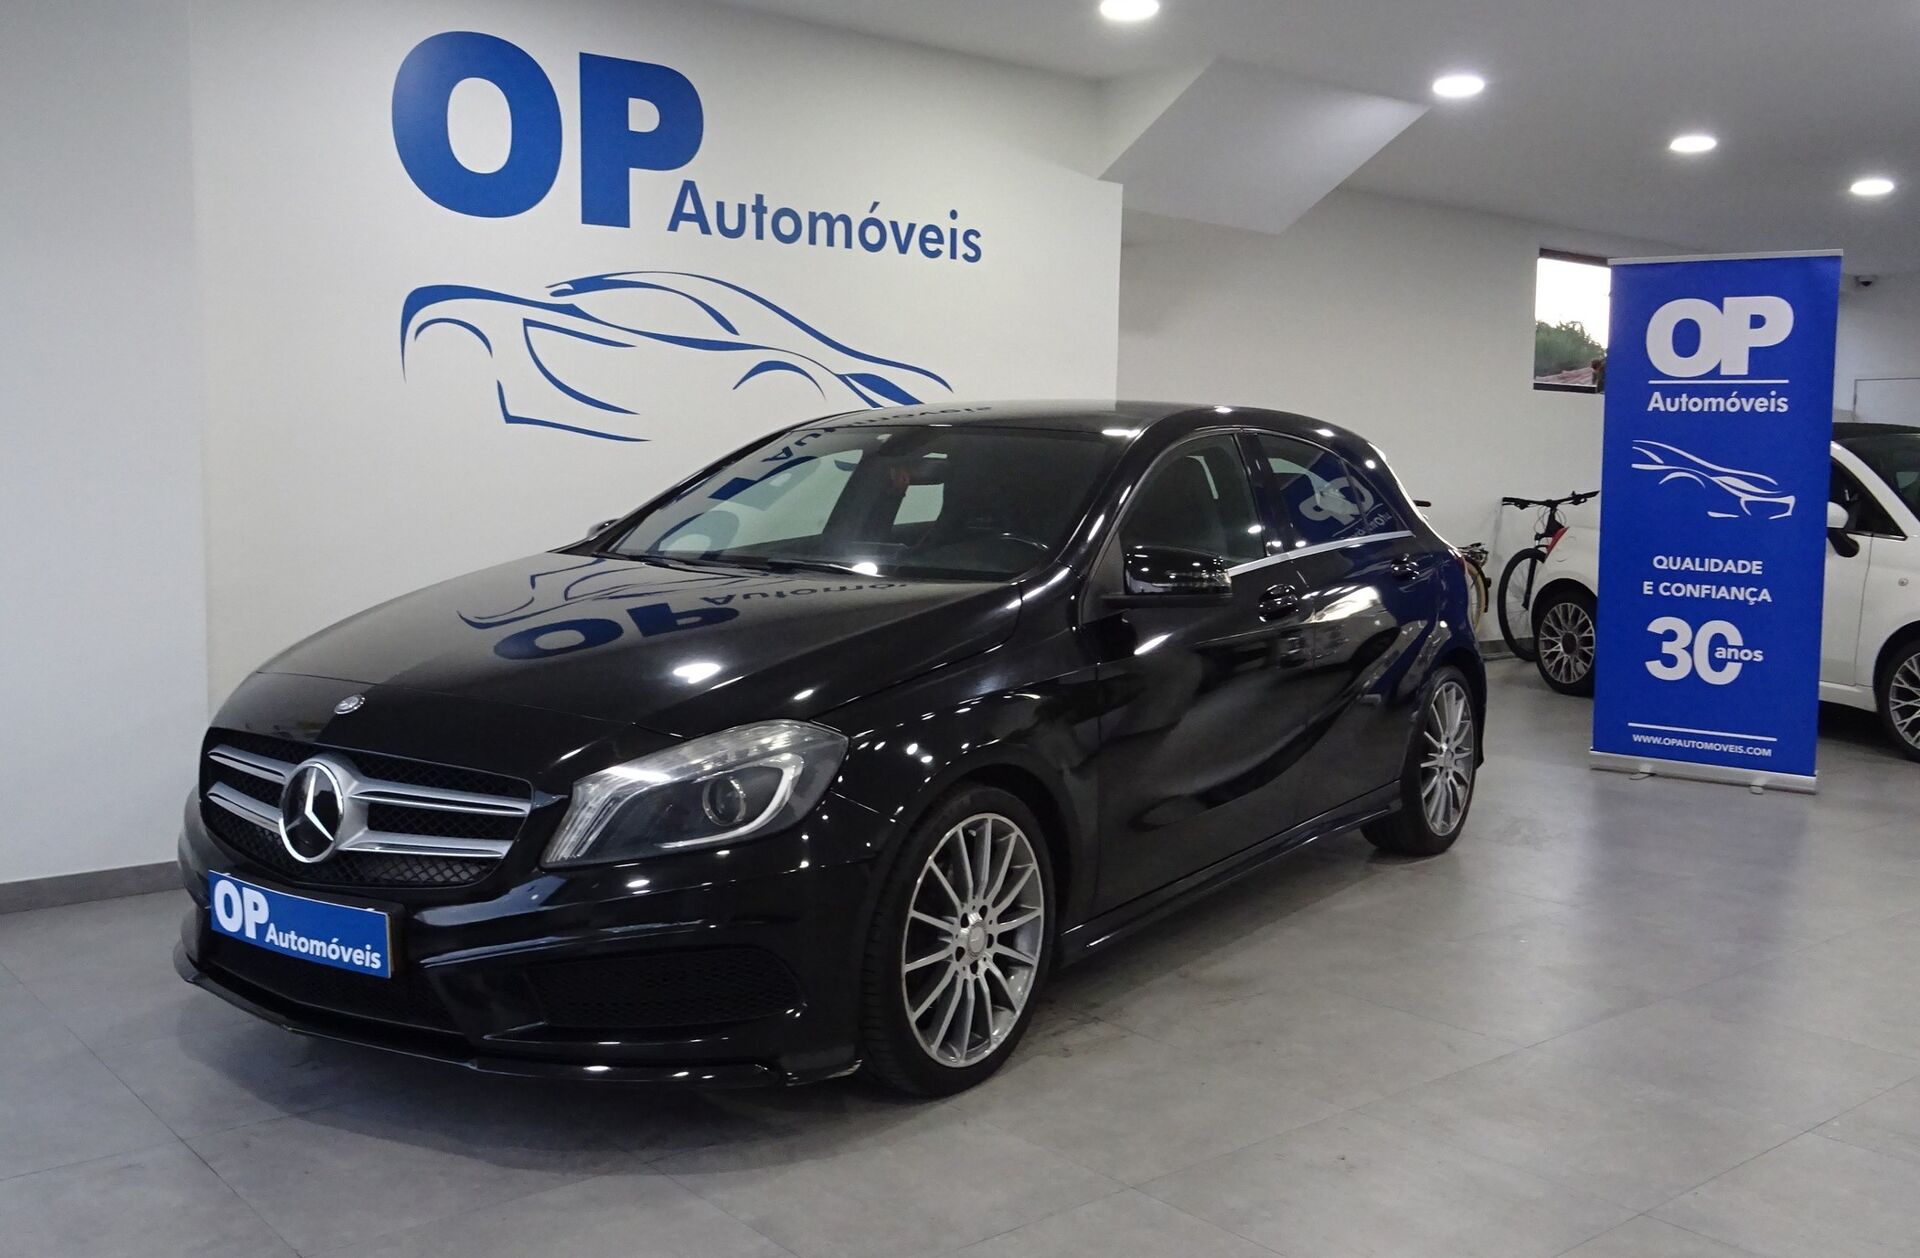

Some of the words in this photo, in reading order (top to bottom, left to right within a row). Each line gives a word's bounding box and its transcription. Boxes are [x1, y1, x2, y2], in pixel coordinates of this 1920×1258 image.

[391, 31, 705, 228] OP
[667, 180, 982, 263] Automóveis
[1645, 295, 1795, 378] OP
[1647, 390, 1789, 413] Automóveis
[1652, 555, 1764, 575] QUALIDADE
[1642, 581, 1654, 595] E
[1658, 582, 1773, 605] CONFIANÇA
[1645, 616, 1745, 686] 30
[1714, 646, 1764, 662] anos
[1632, 733, 1773, 757] WWW.OPAUTOMOVEIS.COM
[214, 879, 270, 940] OP
[264, 922, 382, 969] Automóveis
